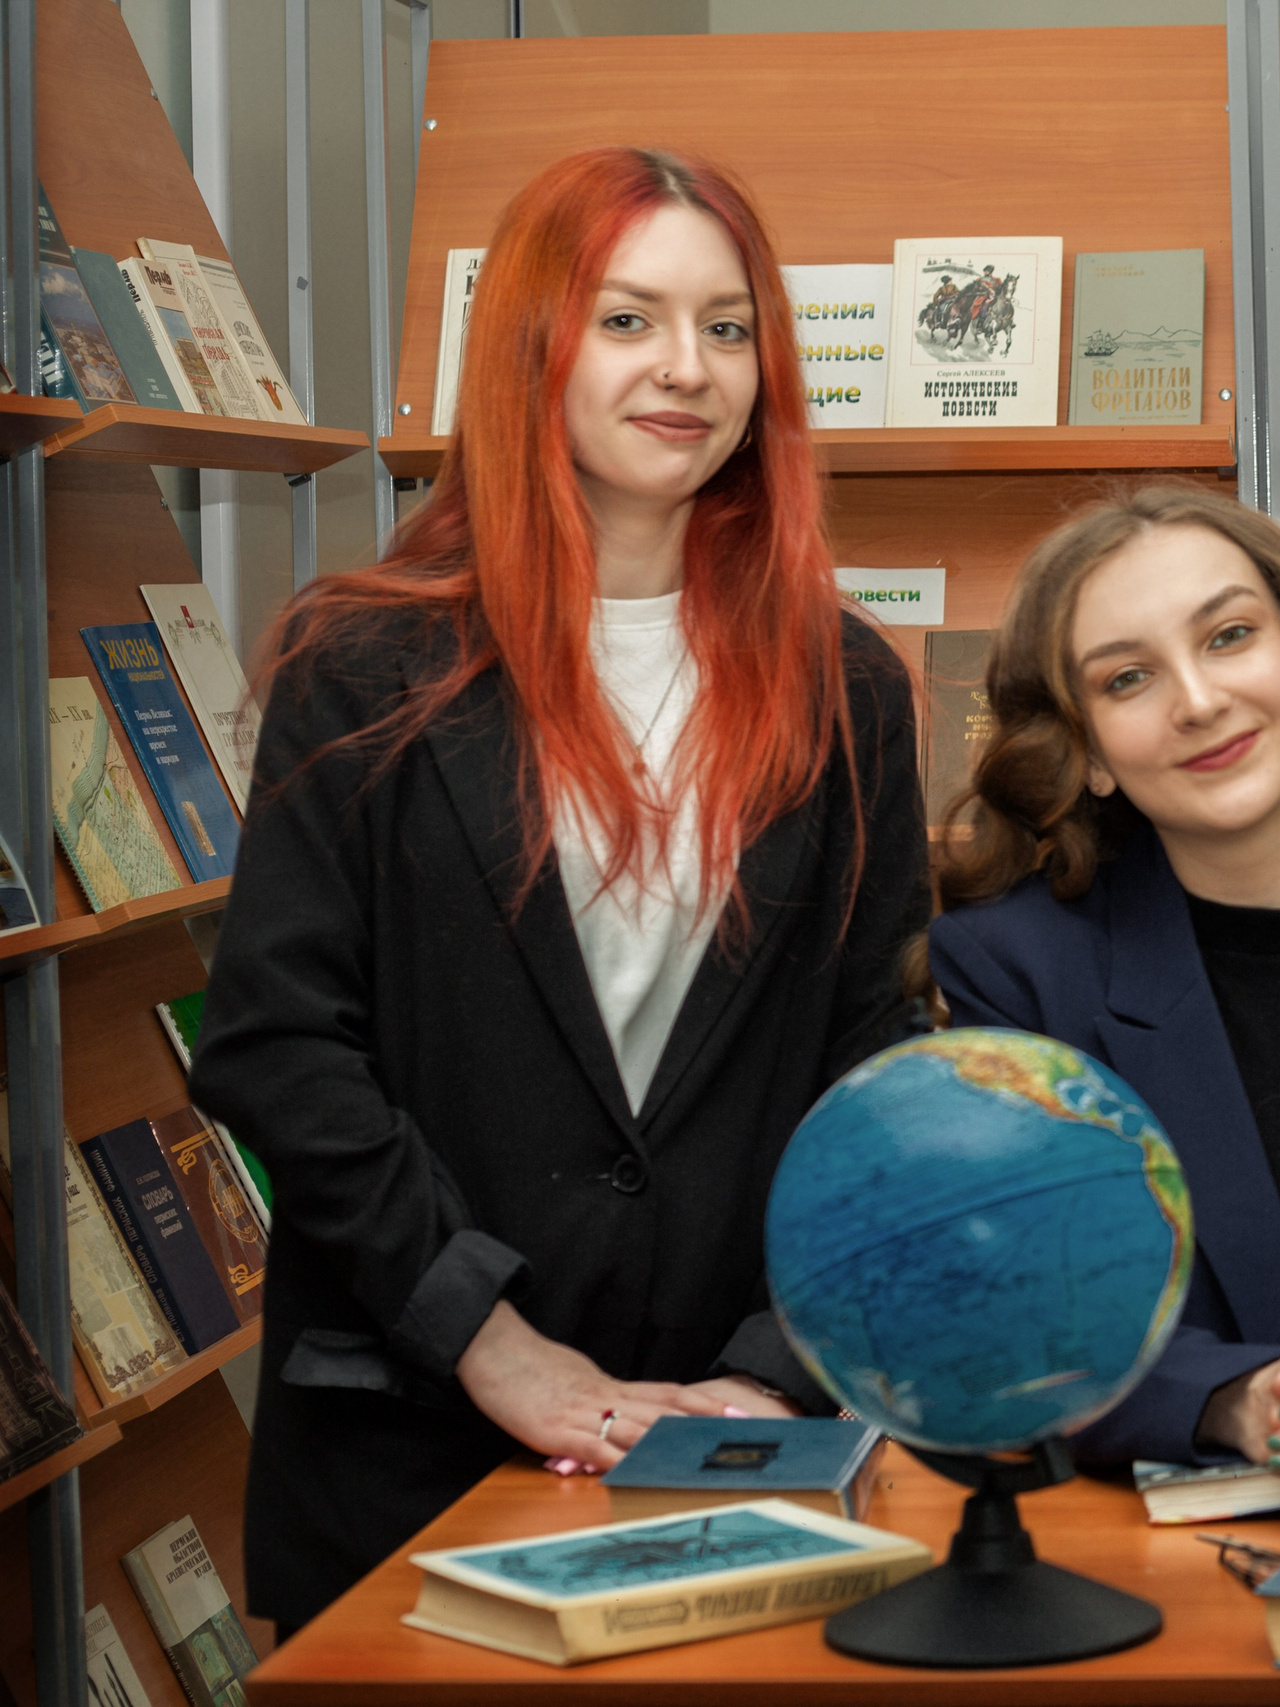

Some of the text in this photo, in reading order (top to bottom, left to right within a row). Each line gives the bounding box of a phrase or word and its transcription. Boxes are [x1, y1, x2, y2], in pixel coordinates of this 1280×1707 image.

[143, 265, 172, 286] Пермь
[937, 368, 1006, 379] Сергей АЛЕКСЕЕВ
[1092, 367, 1191, 391] ВОДИТЕЛИ
[924, 381, 1018, 399] ИСТОРИЧЕСКИЕ
[1091, 389, 1192, 414] ФРЕГАТОВ
[942, 400, 998, 418] ПОВЕСТИ
[99, 636, 160, 671] ЖИЗНЬ
[142, 1184, 175, 1212] СЛОВАРЬ
[111, 1196, 140, 1242] ПЕРМСКИХ
[133, 1243, 158, 1285] СЛОВАРЬ
